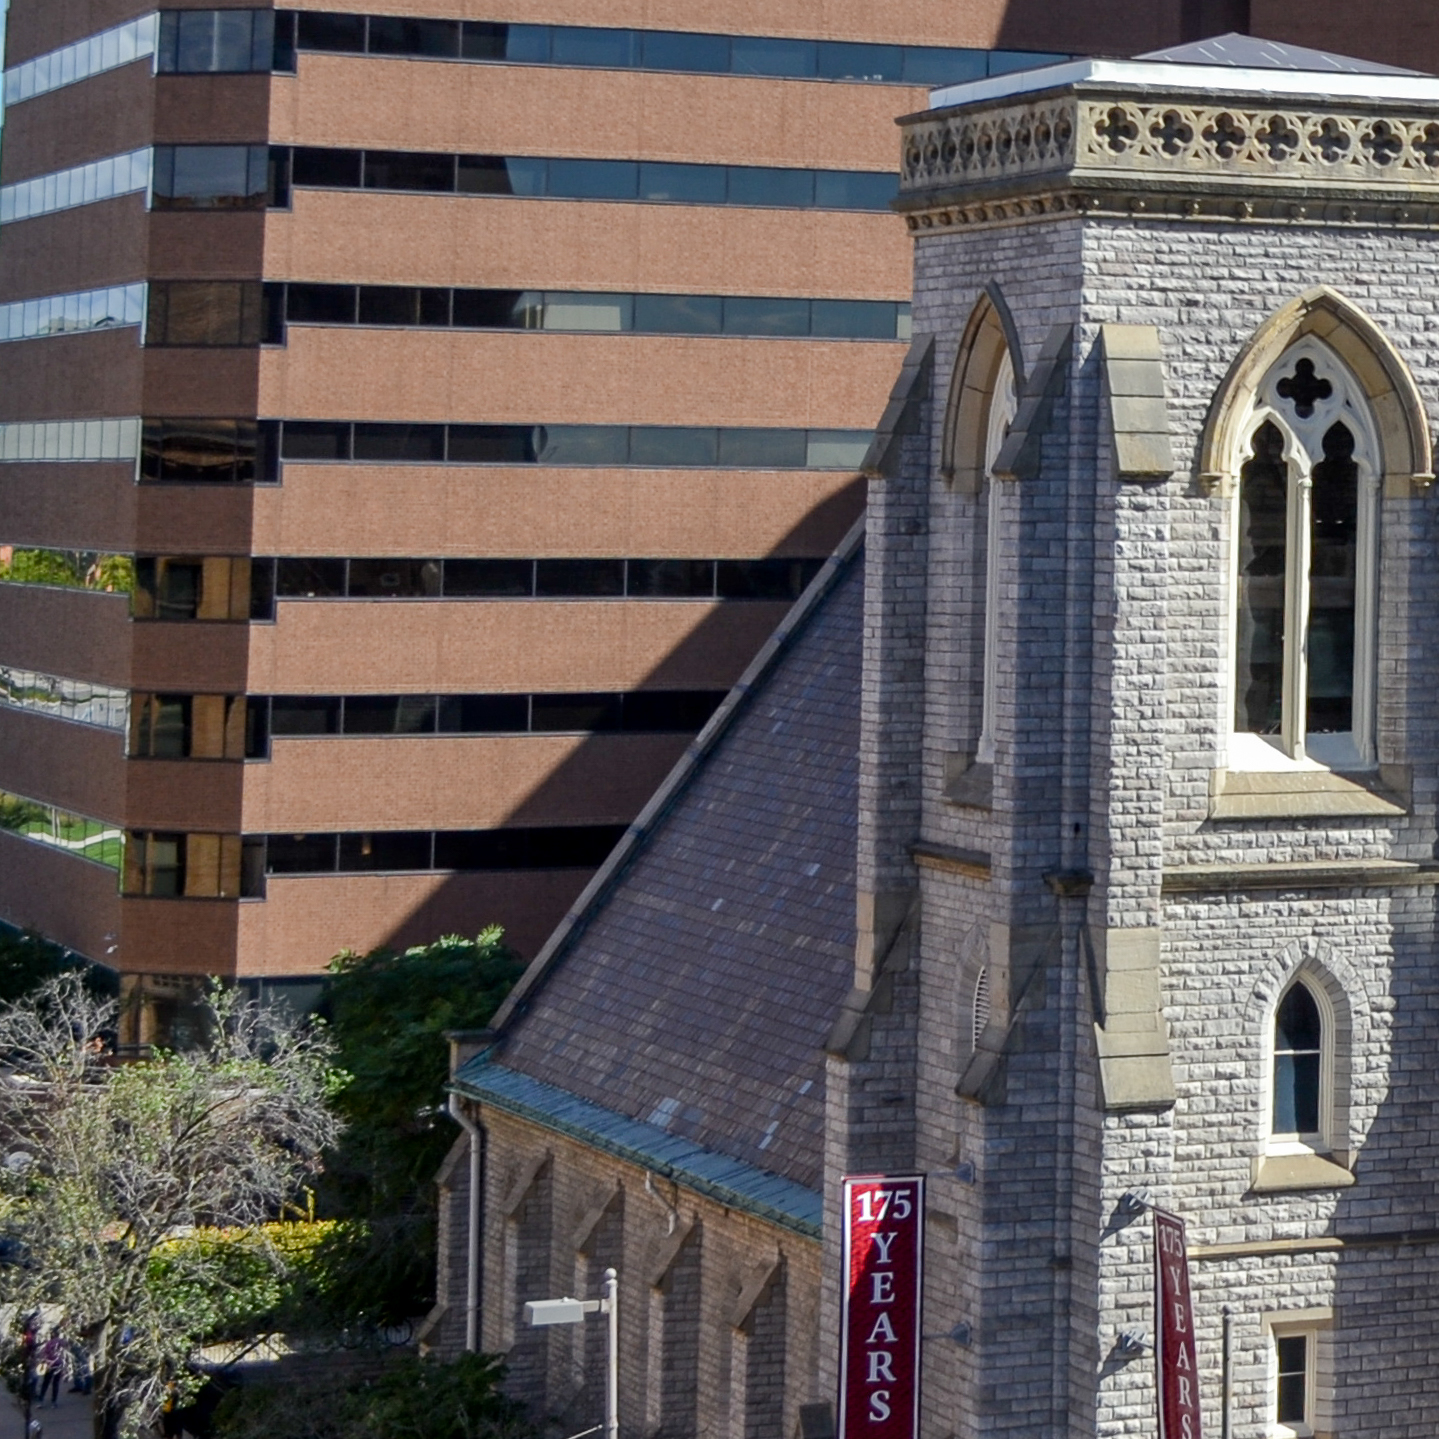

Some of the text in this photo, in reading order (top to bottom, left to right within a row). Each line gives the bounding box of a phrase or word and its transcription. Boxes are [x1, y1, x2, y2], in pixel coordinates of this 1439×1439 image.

[856, 1189, 912, 1222] 175
[1159, 1224, 1183, 1258] 175
[865, 1231, 899, 1422] YEARS
[1169, 1266, 1193, 1439] YEARS
